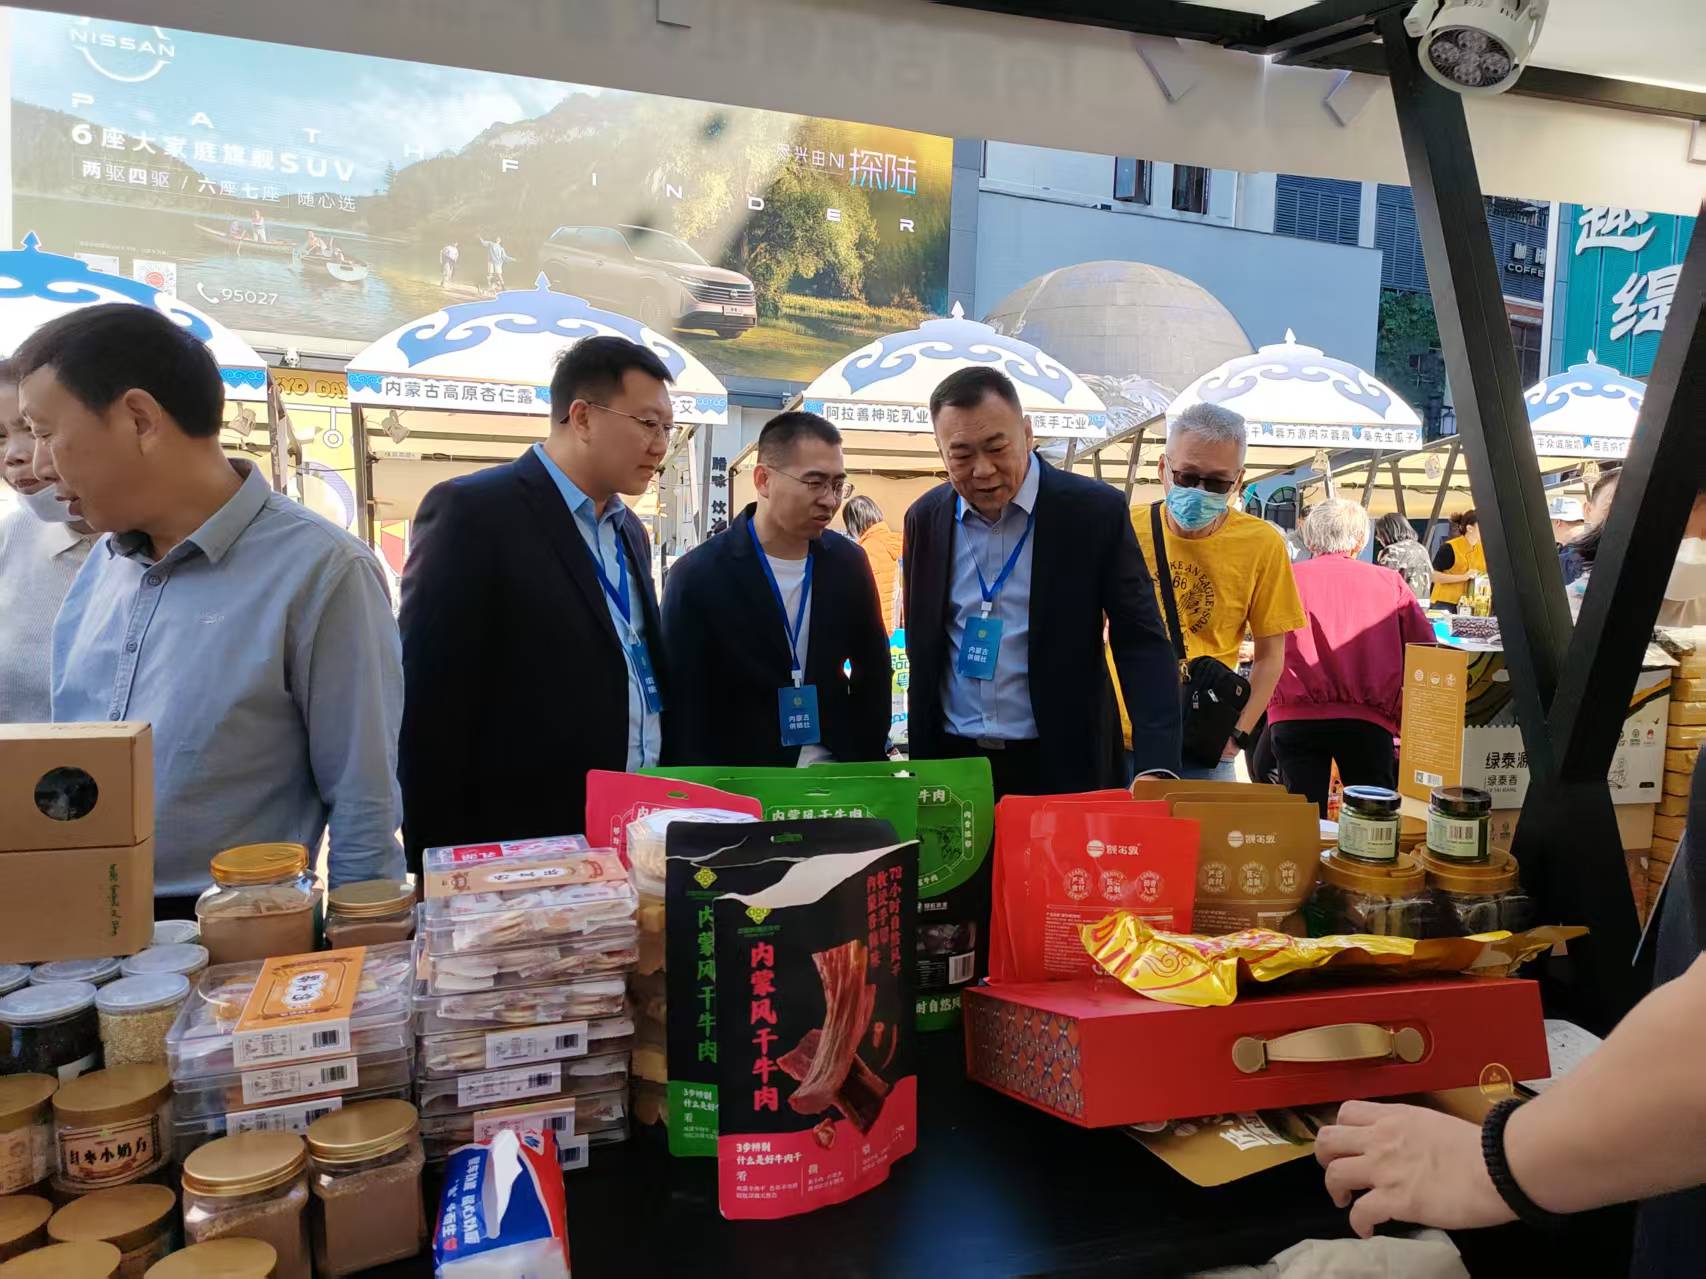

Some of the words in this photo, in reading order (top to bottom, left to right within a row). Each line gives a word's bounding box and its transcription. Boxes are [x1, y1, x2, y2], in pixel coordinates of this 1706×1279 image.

[71, 29, 176, 57] NISSAN
[72, 123, 354, 183] 6座大家庭旗舰SUV
[849, 148, 917, 196] 探陆
[82, 160, 170, 191] 两驱四驱
[198, 177, 281, 203] 六座七座
[297, 190, 357, 214] 随心选
[1513, 242, 1546, 264] 咖啡
[221, 288, 278, 306] 95027
[384, 378, 533, 405] 内蒙古高原杏仁露
[826, 406, 929, 424] 阿拉善神驼乳业
[1485, 751, 1529, 770] 绿泰源
[919, 788, 946, 803] 牛肉
[750, 941, 778, 1112] 内蒙风干牛肉
[736, 1152, 803, 1166] 什么是好牛肉干
